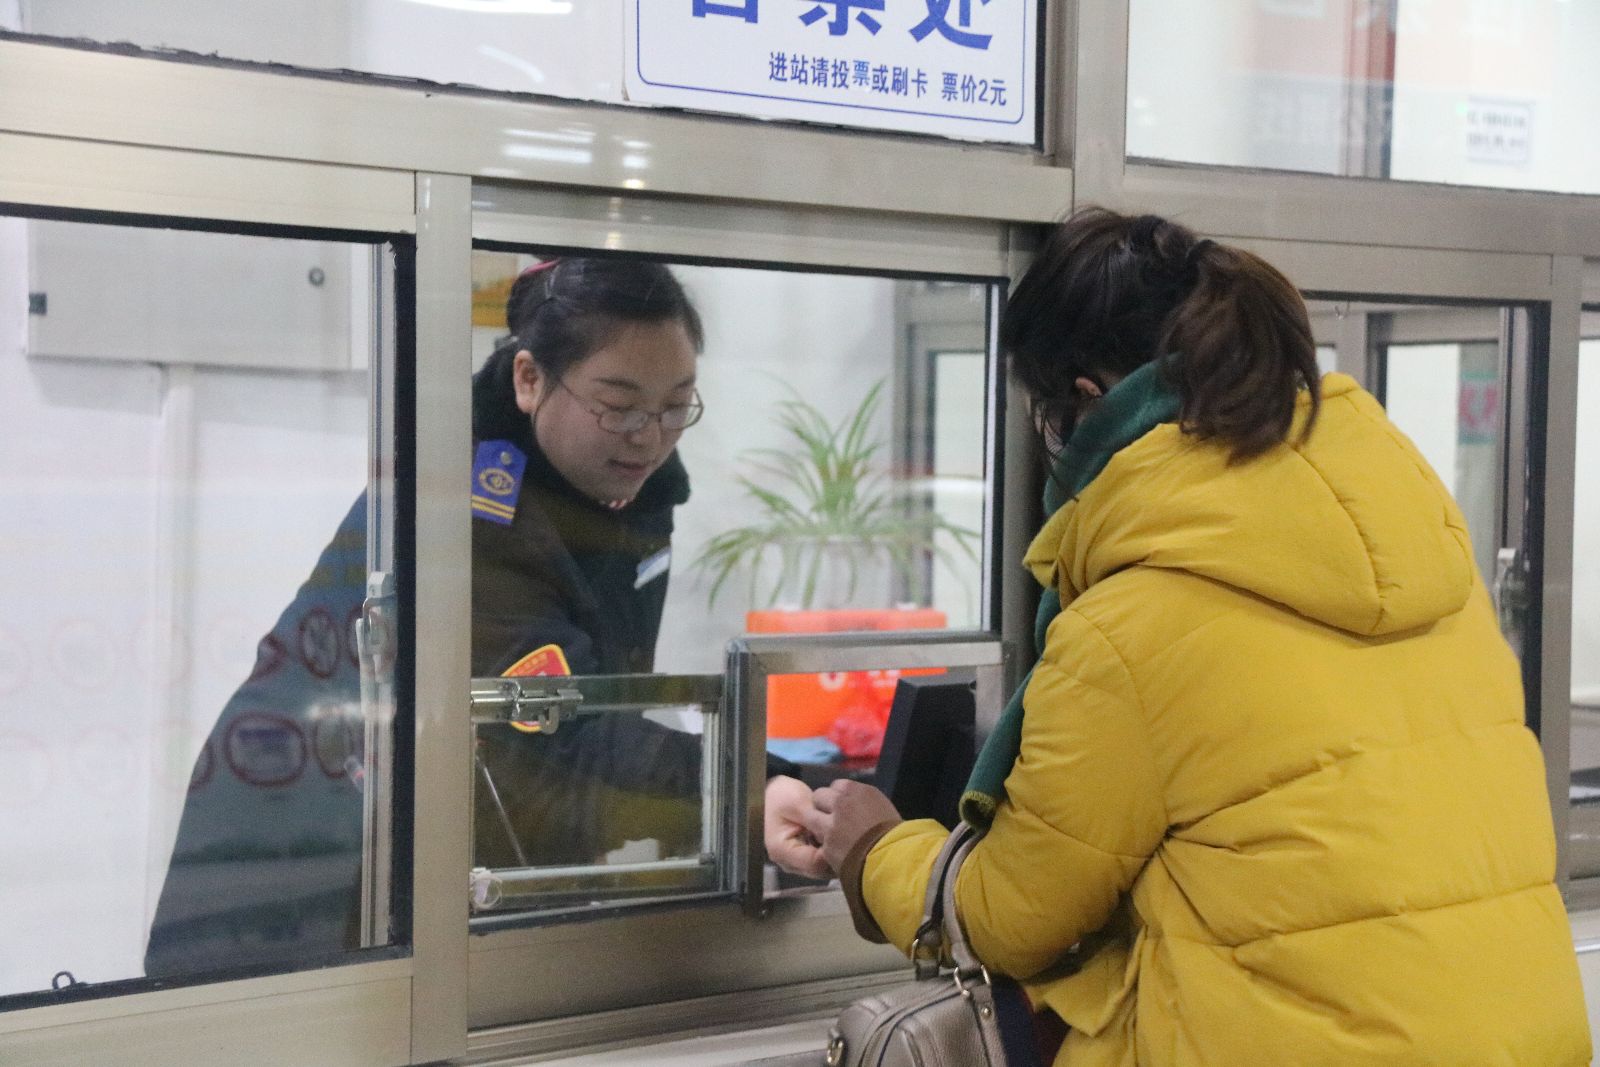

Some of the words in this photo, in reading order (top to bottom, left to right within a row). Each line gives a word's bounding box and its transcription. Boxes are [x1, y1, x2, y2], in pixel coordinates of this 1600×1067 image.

[769, 52, 928, 98] 进站请投票或刷卡
[941, 72, 1007, 106] 票价2元
